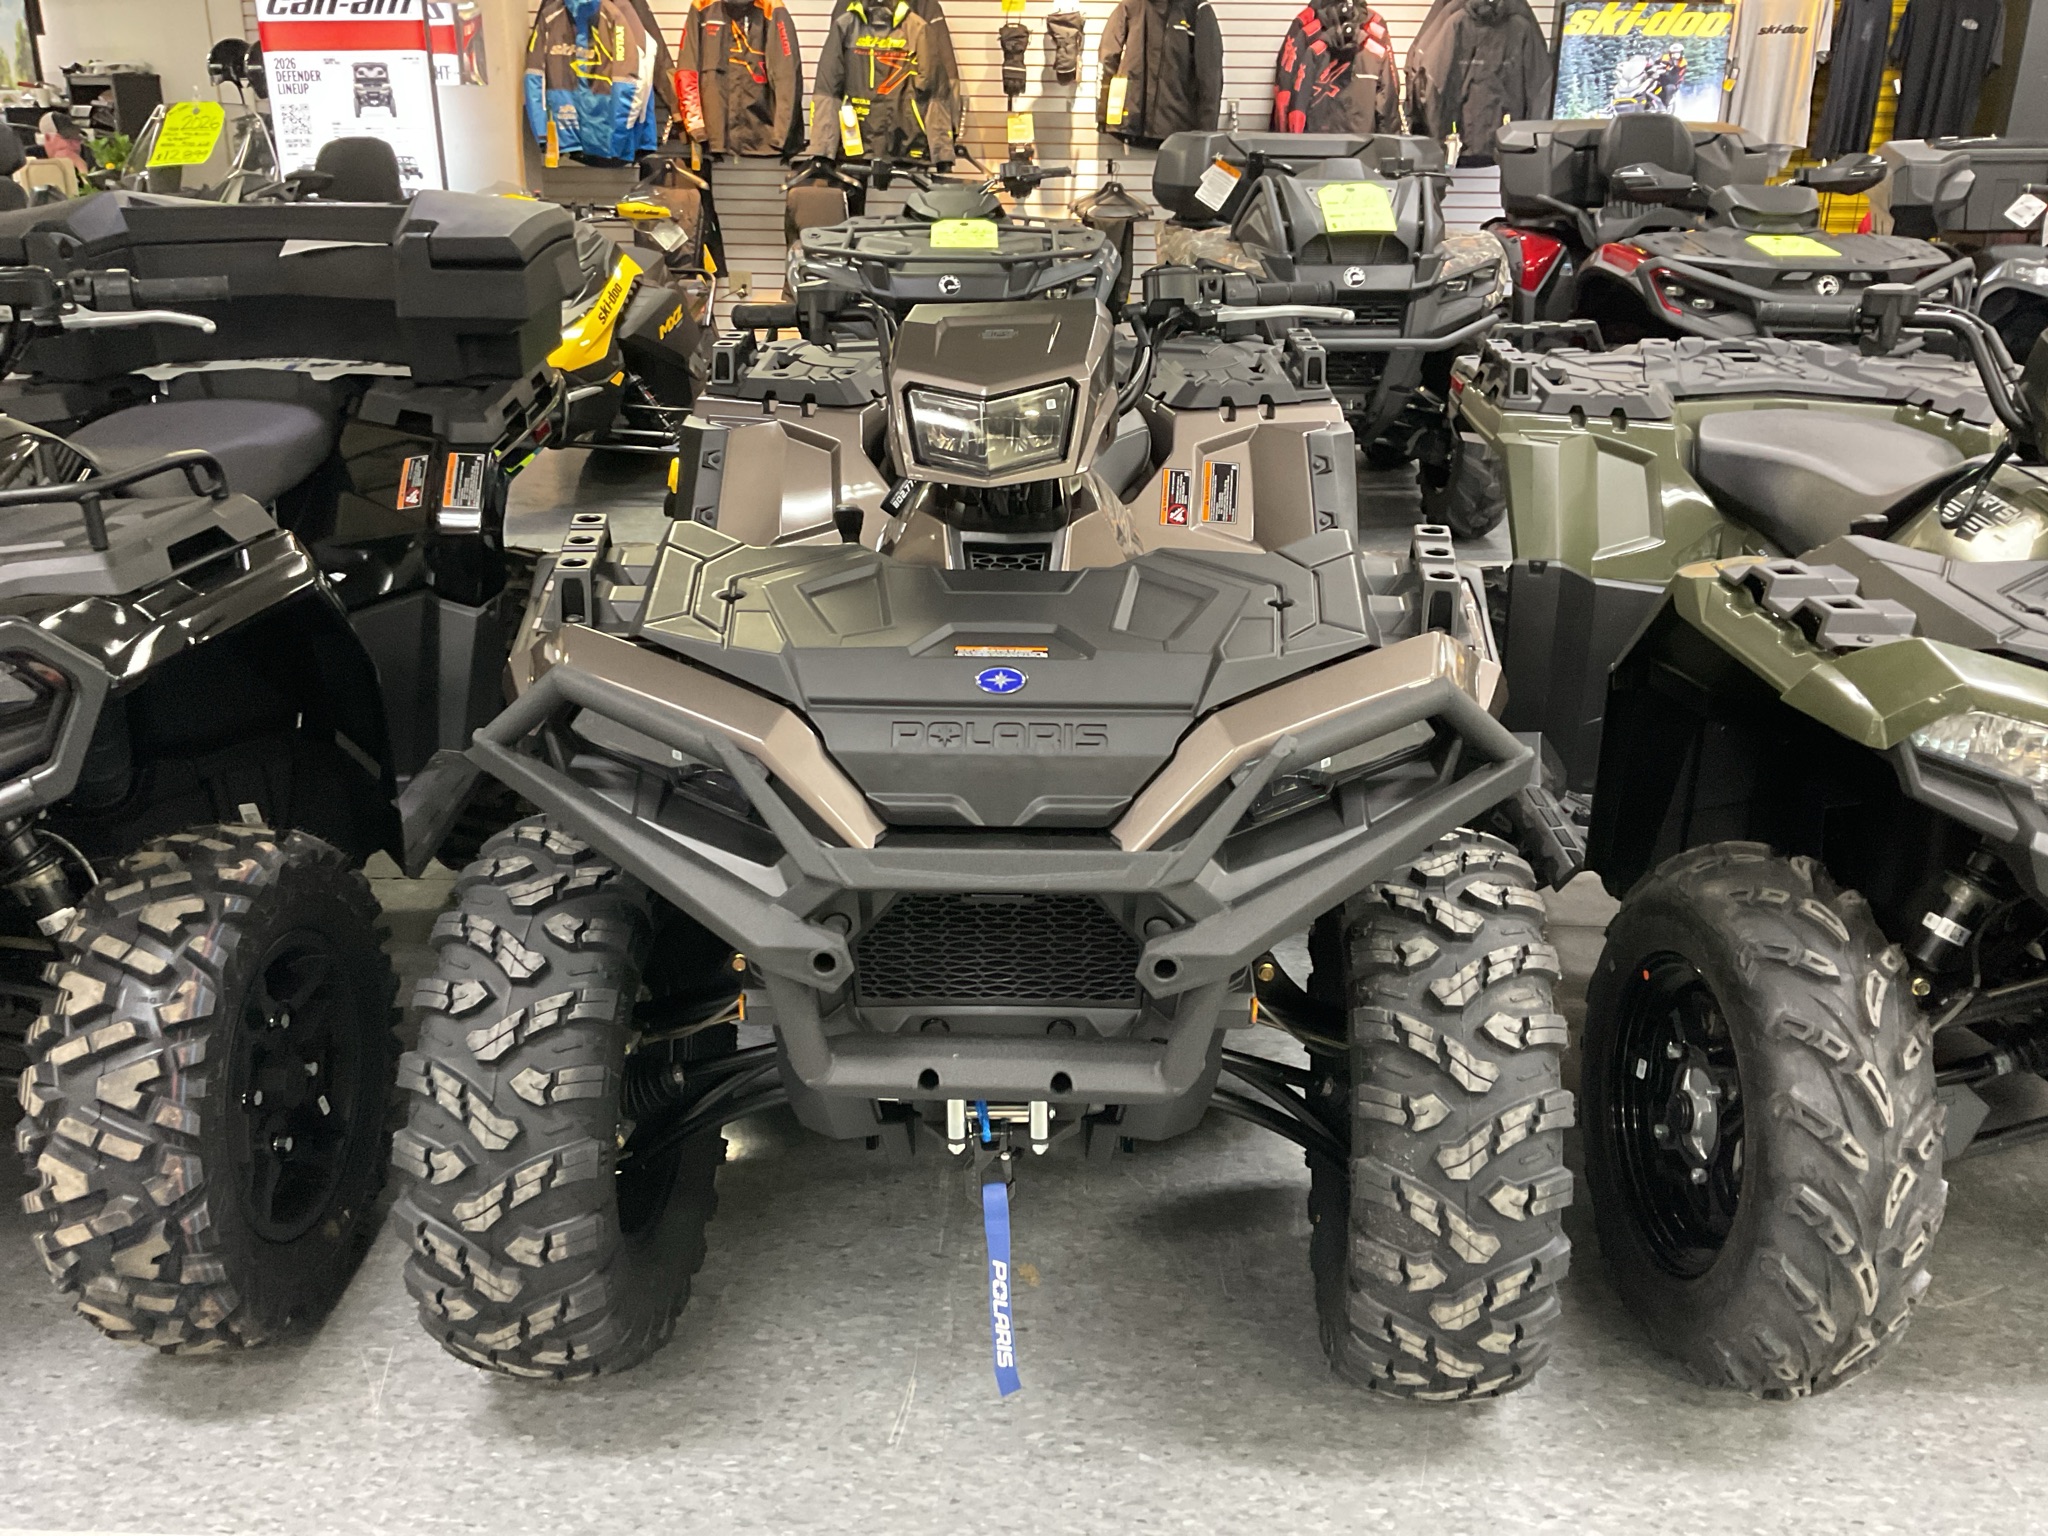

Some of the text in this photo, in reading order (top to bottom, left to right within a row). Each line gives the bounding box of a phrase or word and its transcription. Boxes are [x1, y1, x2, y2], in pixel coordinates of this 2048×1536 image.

[1563, 2, 1733, 37] ski-doo
[1757, 24, 1809, 36] ski-doo
[274, 57, 297, 70] 2026
[275, 70, 322, 82] DEFENDER
[278, 83, 310, 95] LINEUP
[181, 115, 220, 130] 2026
[598, 282, 623, 325] ski-doo
[658, 304, 684, 340] MXZ
[891, 721, 1109, 751] POLARIS
[992, 1259, 1014, 1368] POLARIS
